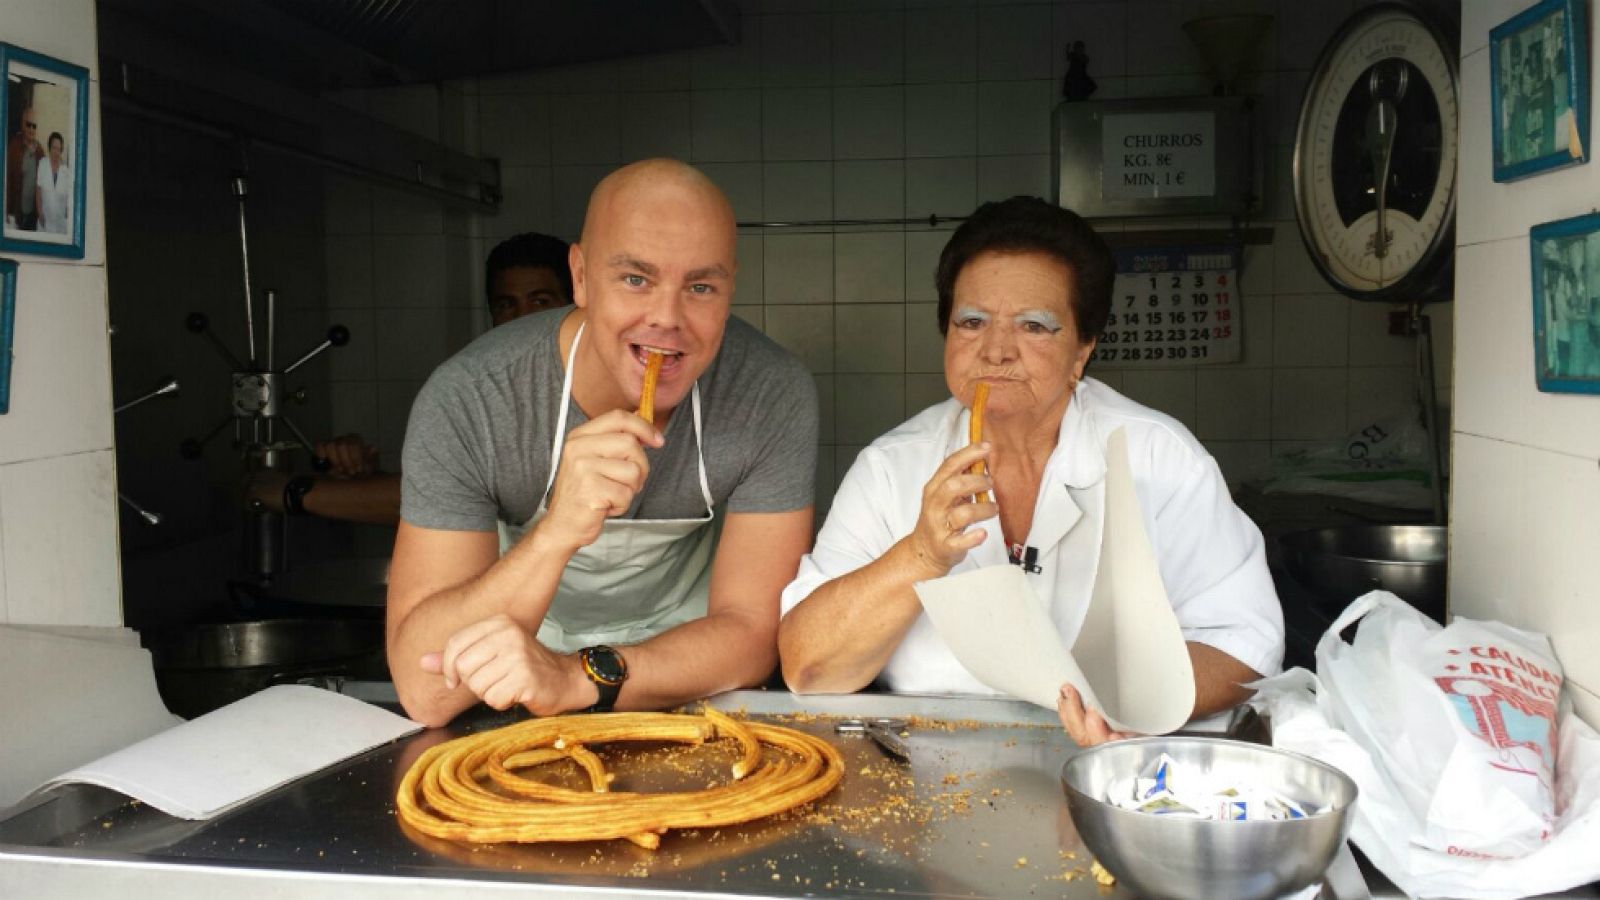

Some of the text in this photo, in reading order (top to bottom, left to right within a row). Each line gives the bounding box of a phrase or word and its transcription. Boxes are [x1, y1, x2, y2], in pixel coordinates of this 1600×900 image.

[1123, 133, 1203, 148] CHURROS
[1124, 153, 1173, 167] KG. 8€
[1124, 170, 1185, 186] MIN. 1 €
[1150, 275, 1227, 289] 1 2 3 4
[1126, 292, 1229, 307] 7 8 9 10 11
[1123, 313, 1139, 325] 14
[1146, 312, 1162, 325] 15
[1168, 312, 1186, 324] 16
[1192, 311, 1208, 322] 17
[1216, 309, 1231, 321] 18
[1100, 327, 1231, 344] 20 21 22 23 24 25
[1100, 348, 1118, 360] 27
[1122, 348, 1141, 360] 28
[1144, 347, 1164, 360] 29
[1168, 346, 1187, 358] 30
[1191, 346, 1208, 358] 31
